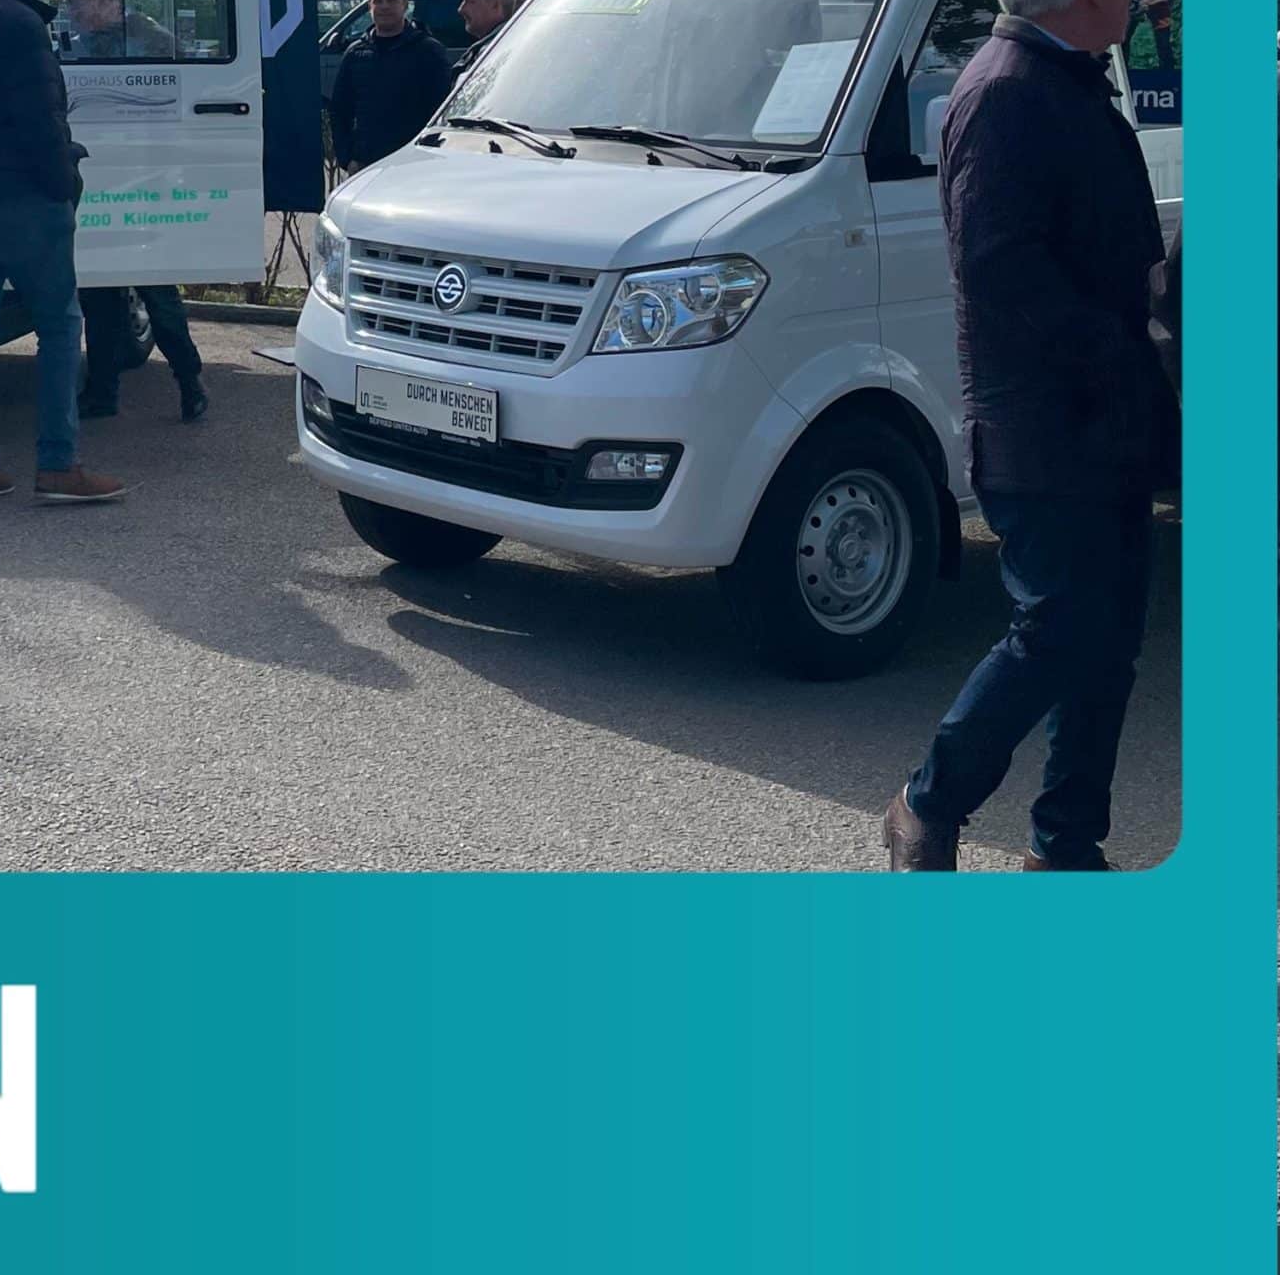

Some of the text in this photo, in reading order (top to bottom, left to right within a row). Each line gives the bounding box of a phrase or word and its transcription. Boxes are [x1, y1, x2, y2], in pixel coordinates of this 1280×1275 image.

[125, 75, 177, 86] GRUBER
[1132, 89, 1175, 108] rna
[83, 187, 229, 204] ichweite bis zu
[80, 211, 211, 227] 200 Kilometer
[407, 383, 437, 403] DURCH
[440, 389, 493, 414] MENSCHEN
[452, 410, 493, 434] BEWEGT
